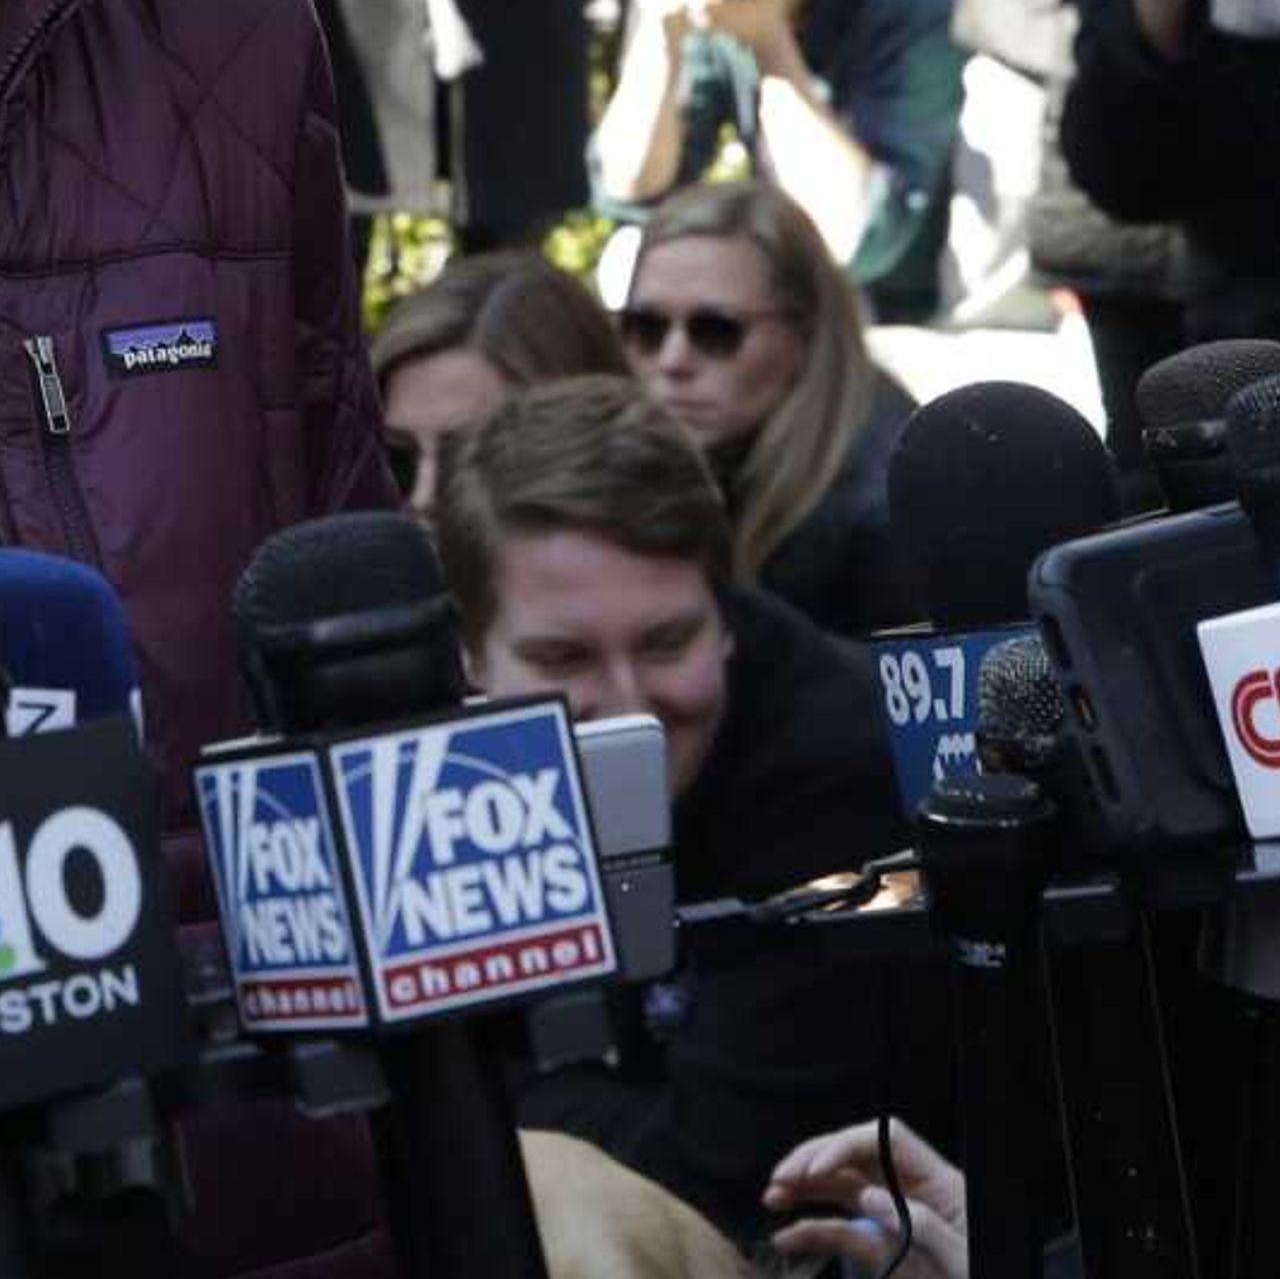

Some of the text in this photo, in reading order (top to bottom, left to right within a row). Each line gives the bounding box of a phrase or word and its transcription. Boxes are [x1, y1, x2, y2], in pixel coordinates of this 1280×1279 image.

[122, 342, 213, 370] patagonia
[879, 646, 966, 726] 89.7
[424, 768, 575, 866] FOX
[248, 817, 333, 894] FOX
[239, 896, 347, 965] NEWS
[389, 845, 588, 948] NEWS
[244, 981, 358, 1016] channel
[388, 927, 600, 1002] channel
